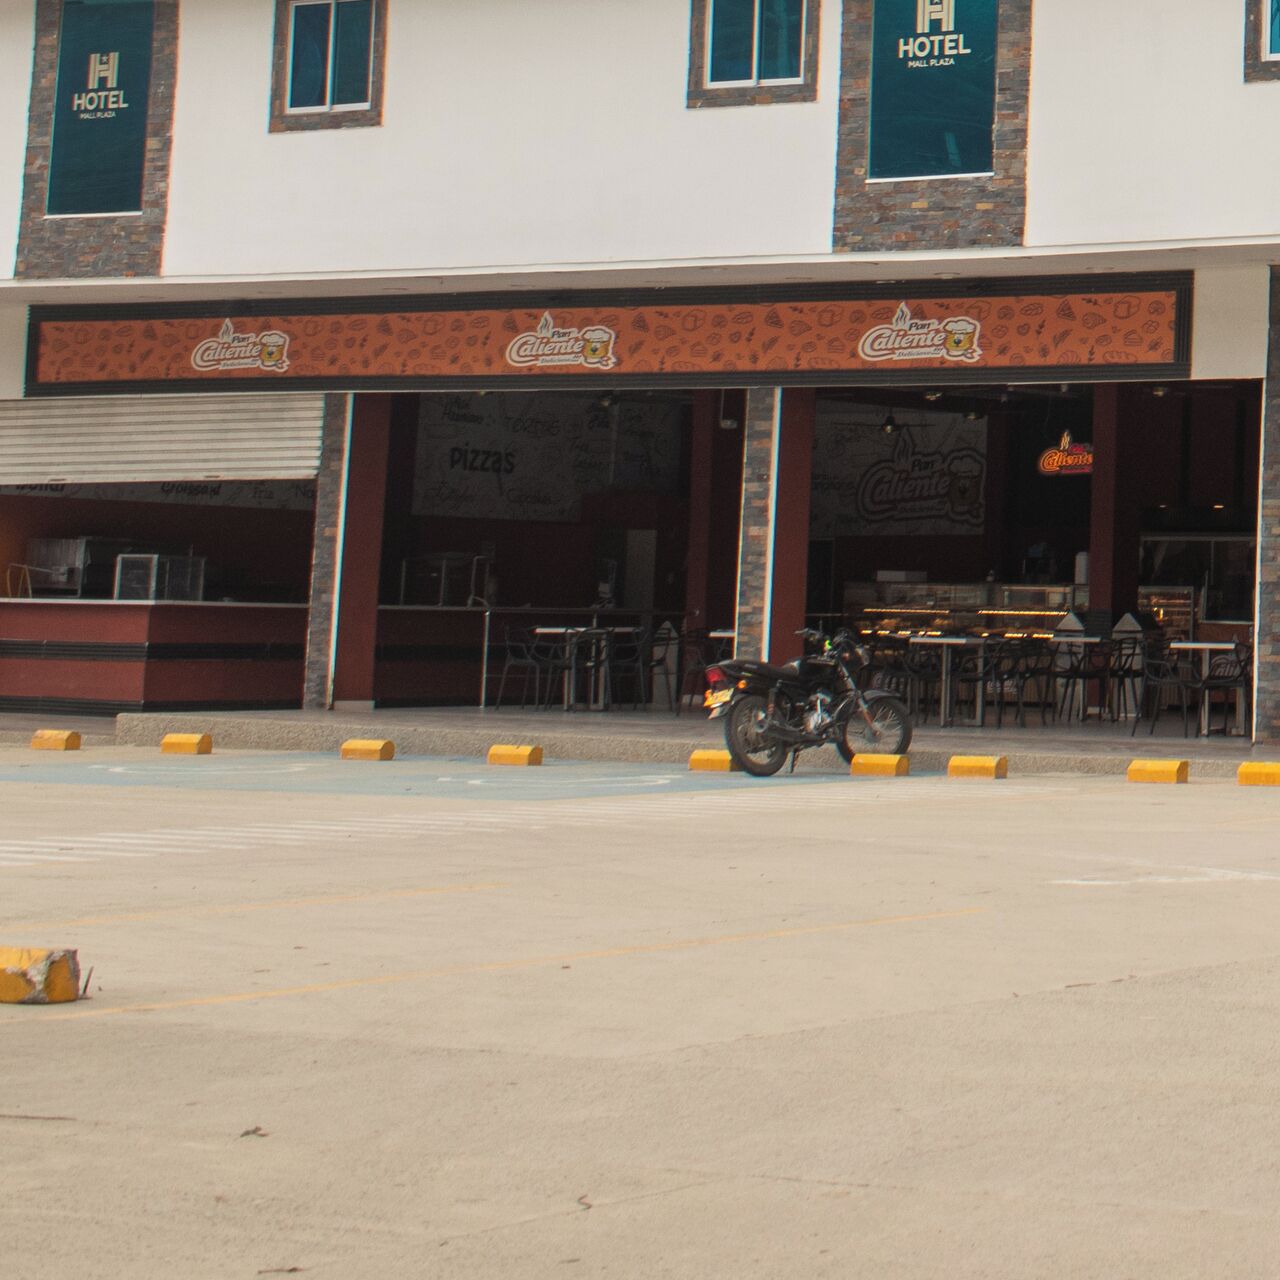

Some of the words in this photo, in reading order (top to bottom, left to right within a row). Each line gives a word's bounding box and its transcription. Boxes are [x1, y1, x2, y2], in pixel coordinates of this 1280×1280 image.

[898, 34, 972, 58] HOTEL
[908, 59, 928, 68] MALL
[929, 58, 955, 67] PLAZA
[72, 90, 129, 111] HOTEL
[80, 112, 96, 120] MALL
[96, 111, 116, 119] PLAZA
[908, 322, 931, 331] Pan
[194, 340, 261, 366] Caliente
[510, 334, 584, 361] Caliente
[863, 327, 946, 357] Caliente
